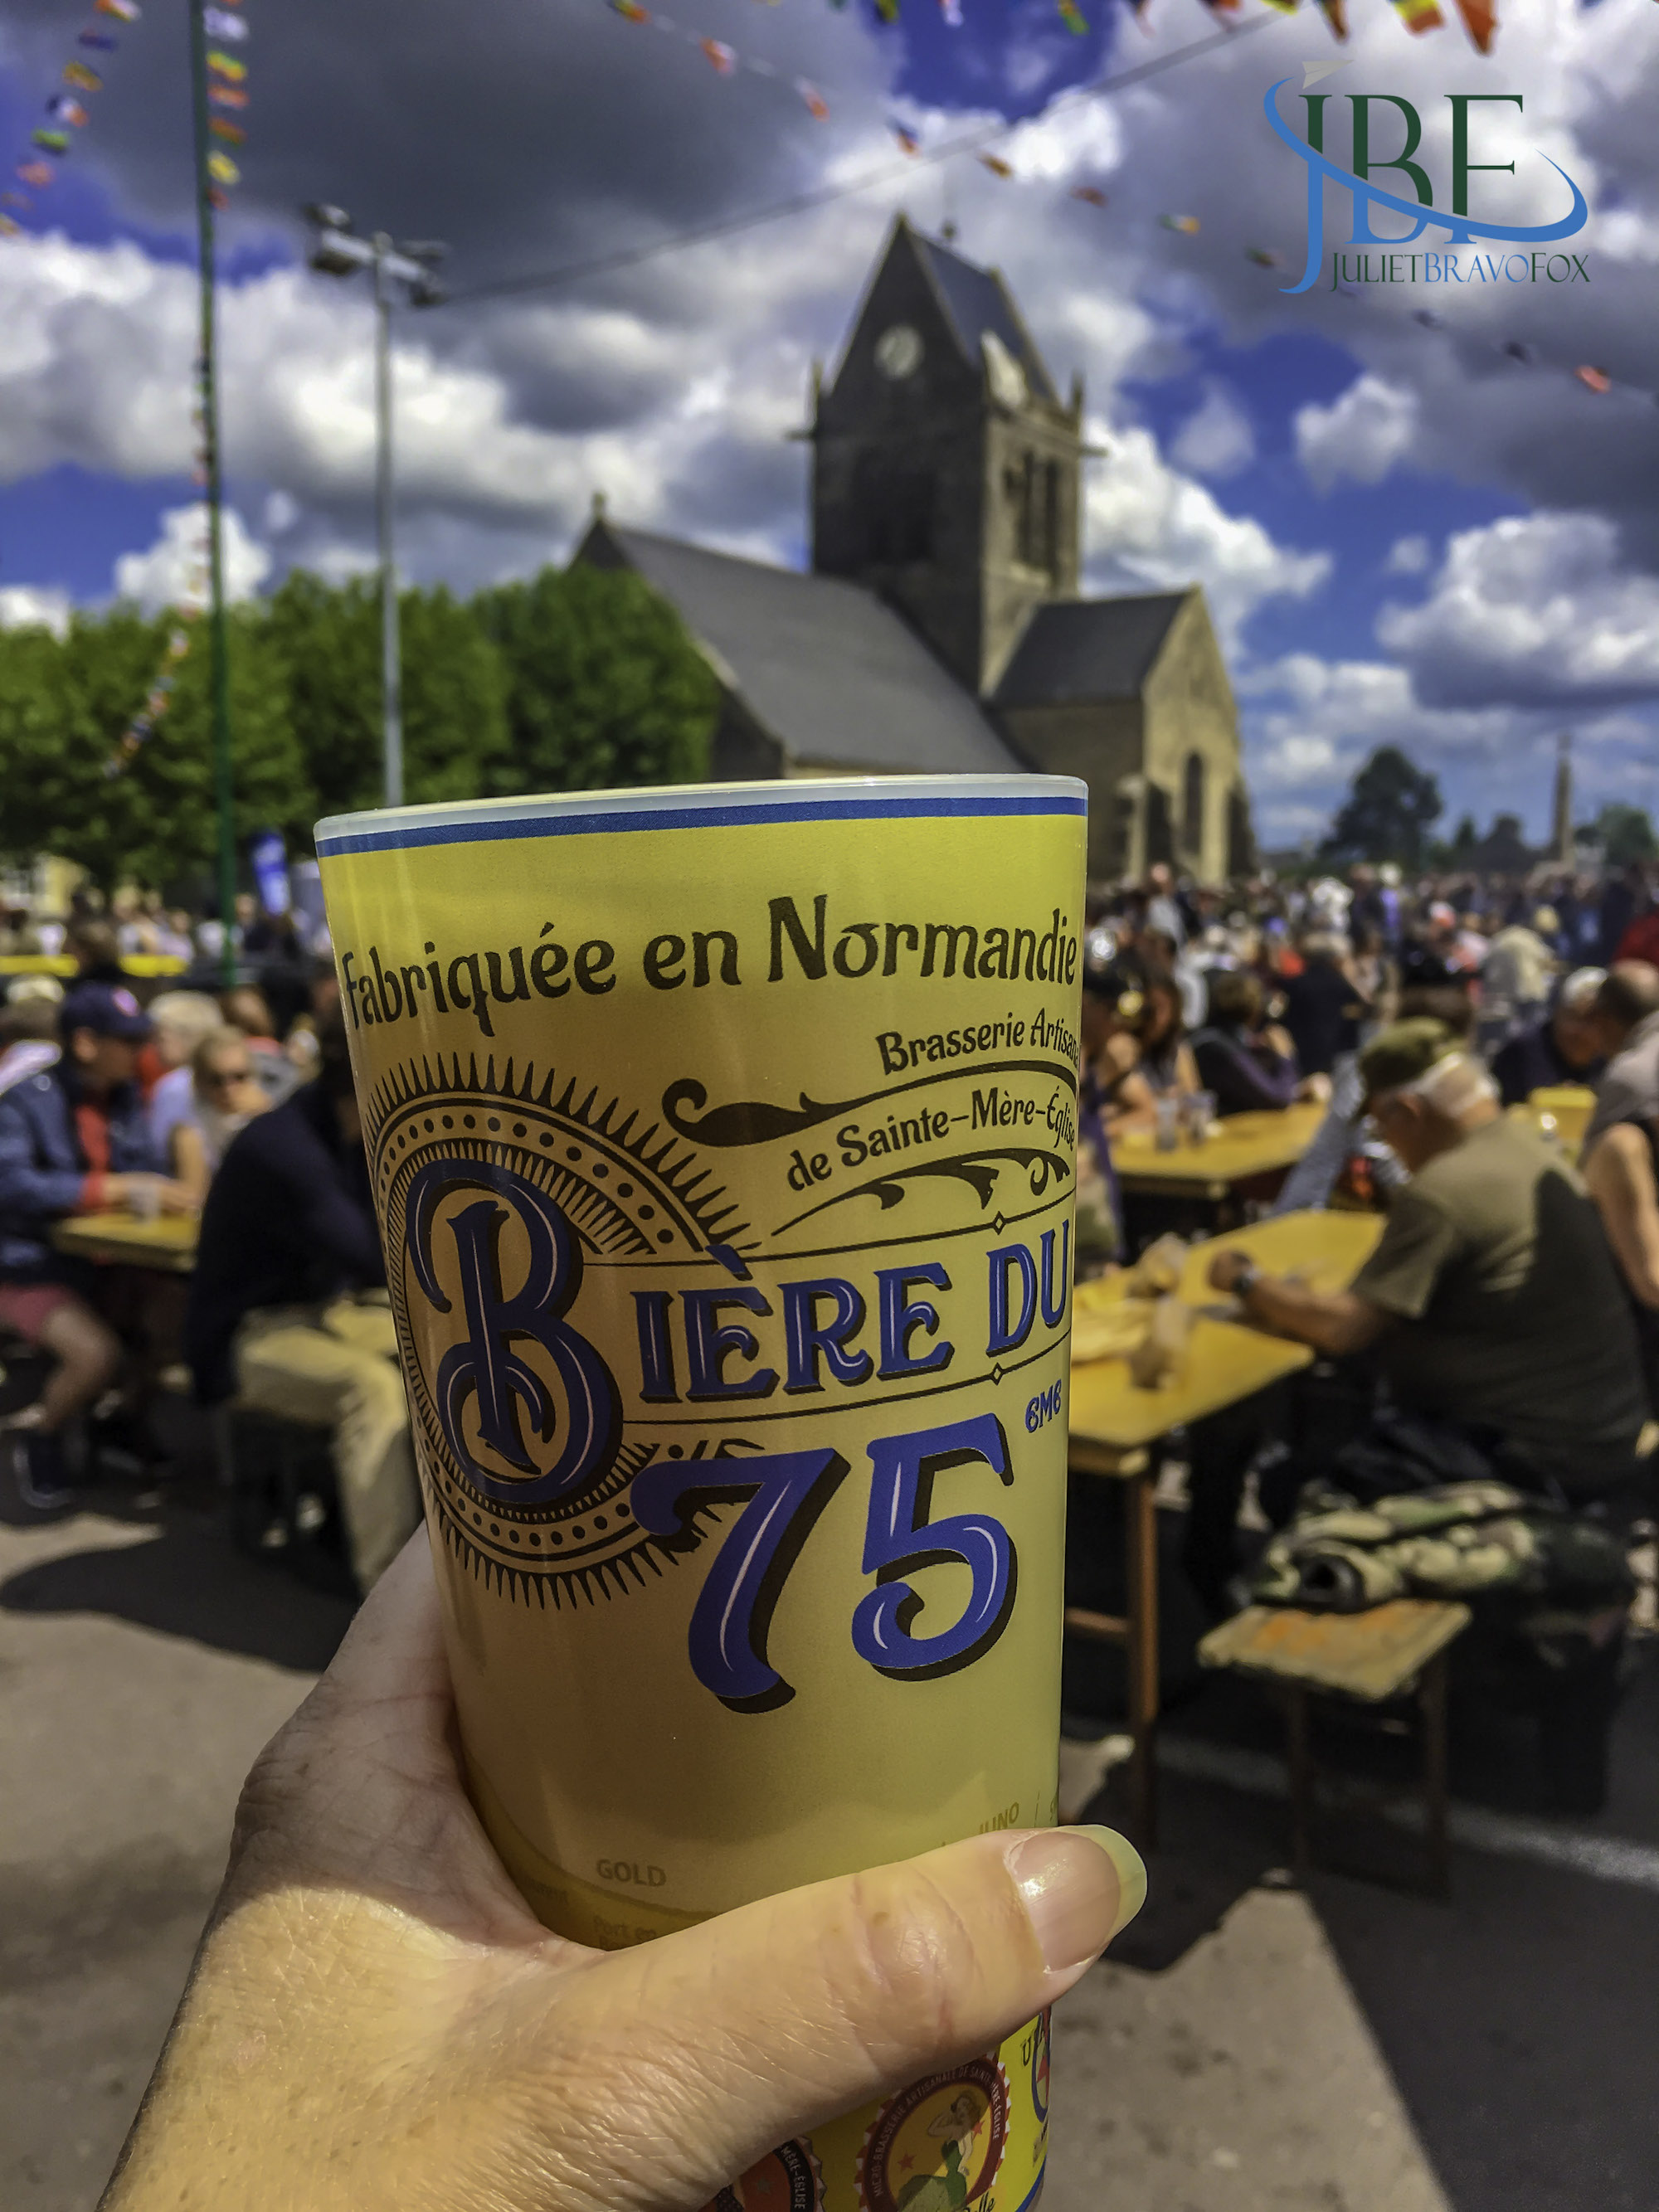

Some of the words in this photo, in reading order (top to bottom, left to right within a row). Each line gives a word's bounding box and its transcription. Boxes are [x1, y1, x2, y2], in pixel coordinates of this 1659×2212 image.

[643, 930, 742, 990] en
[767, 894, 1078, 986] Normandie
[875, 1011, 1025, 1076] Brasserie
[787, 1150, 833, 1191] de
[836, 1085, 1075, 1168] Sainte-Mère-Église
[406, 1158, 956, 1510] BIÈRE
[985, 1218, 1070, 1359] DU
[630, 1412, 1018, 1714] 75
[596, 1859, 667, 1887] GOLD
